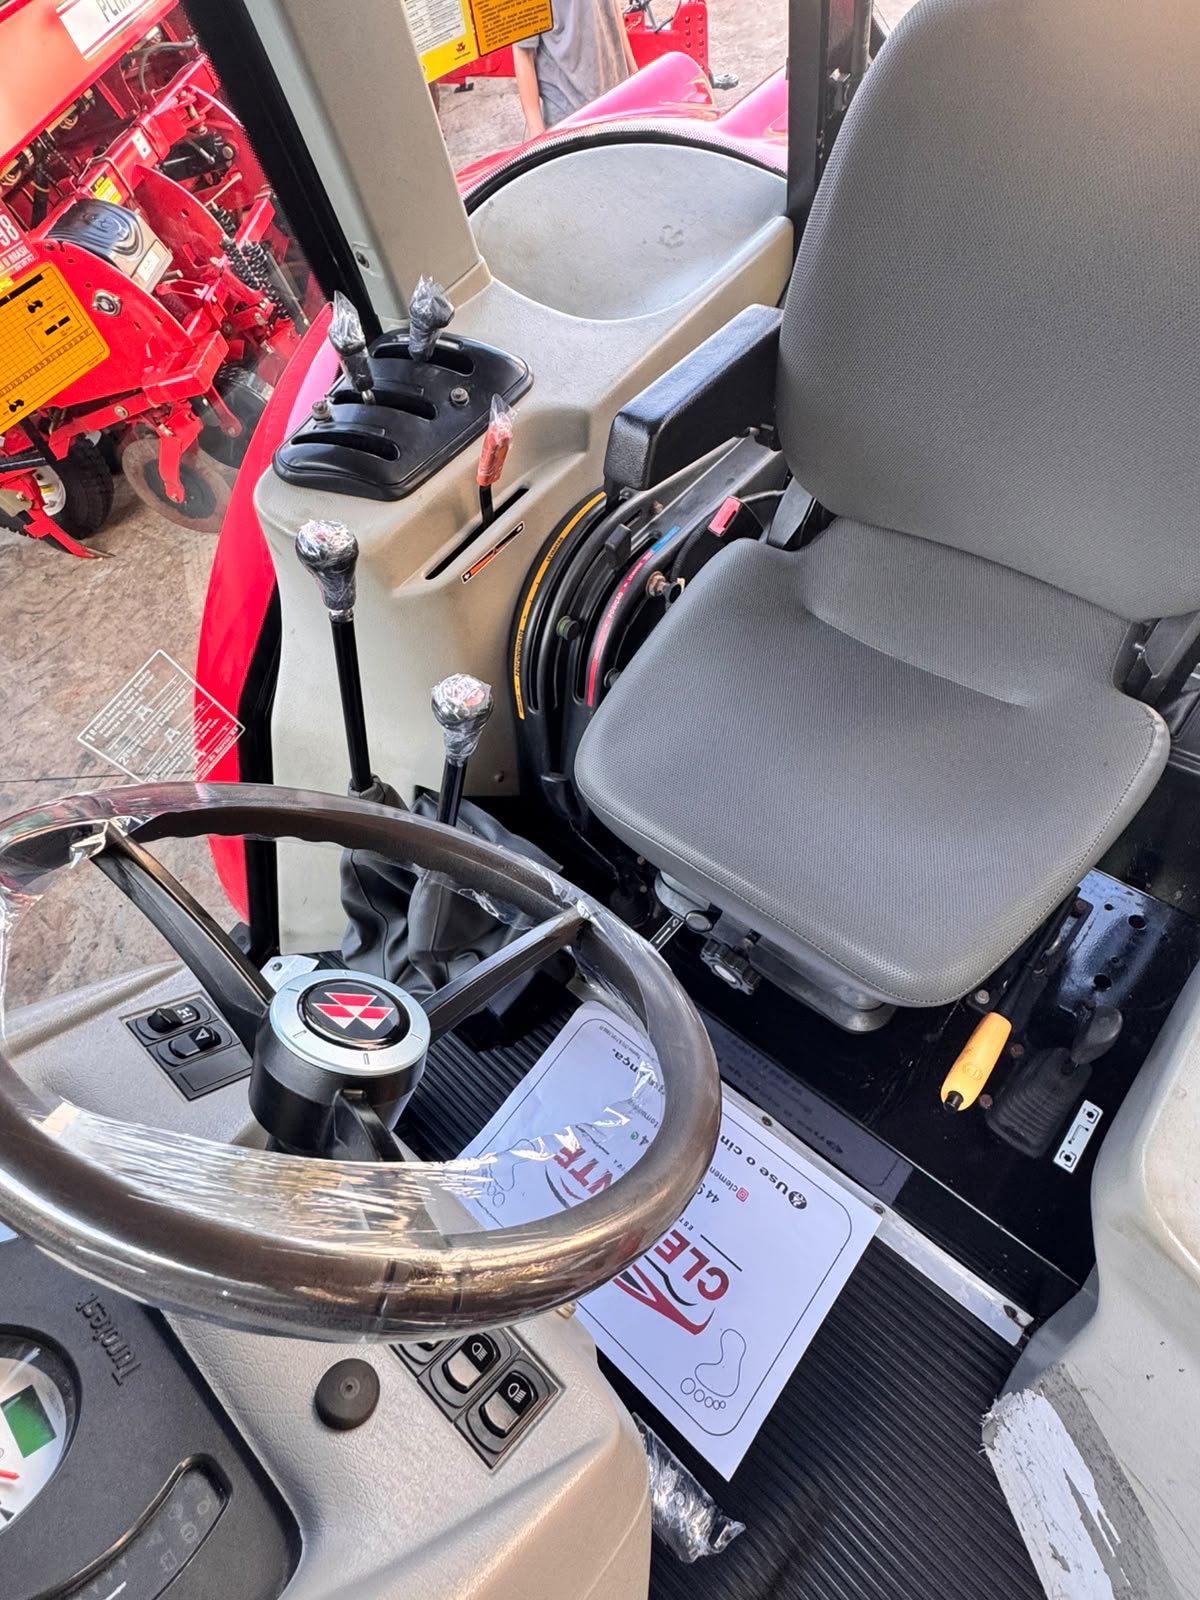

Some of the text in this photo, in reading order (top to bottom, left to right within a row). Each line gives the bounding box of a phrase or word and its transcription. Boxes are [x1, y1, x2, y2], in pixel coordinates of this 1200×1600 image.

[608, 591, 624, 619] POSIÇÃO
[746, 1156, 756, 1166] o
[760, 1167, 789, 1195] Use
[706, 1190, 720, 1204] 44
